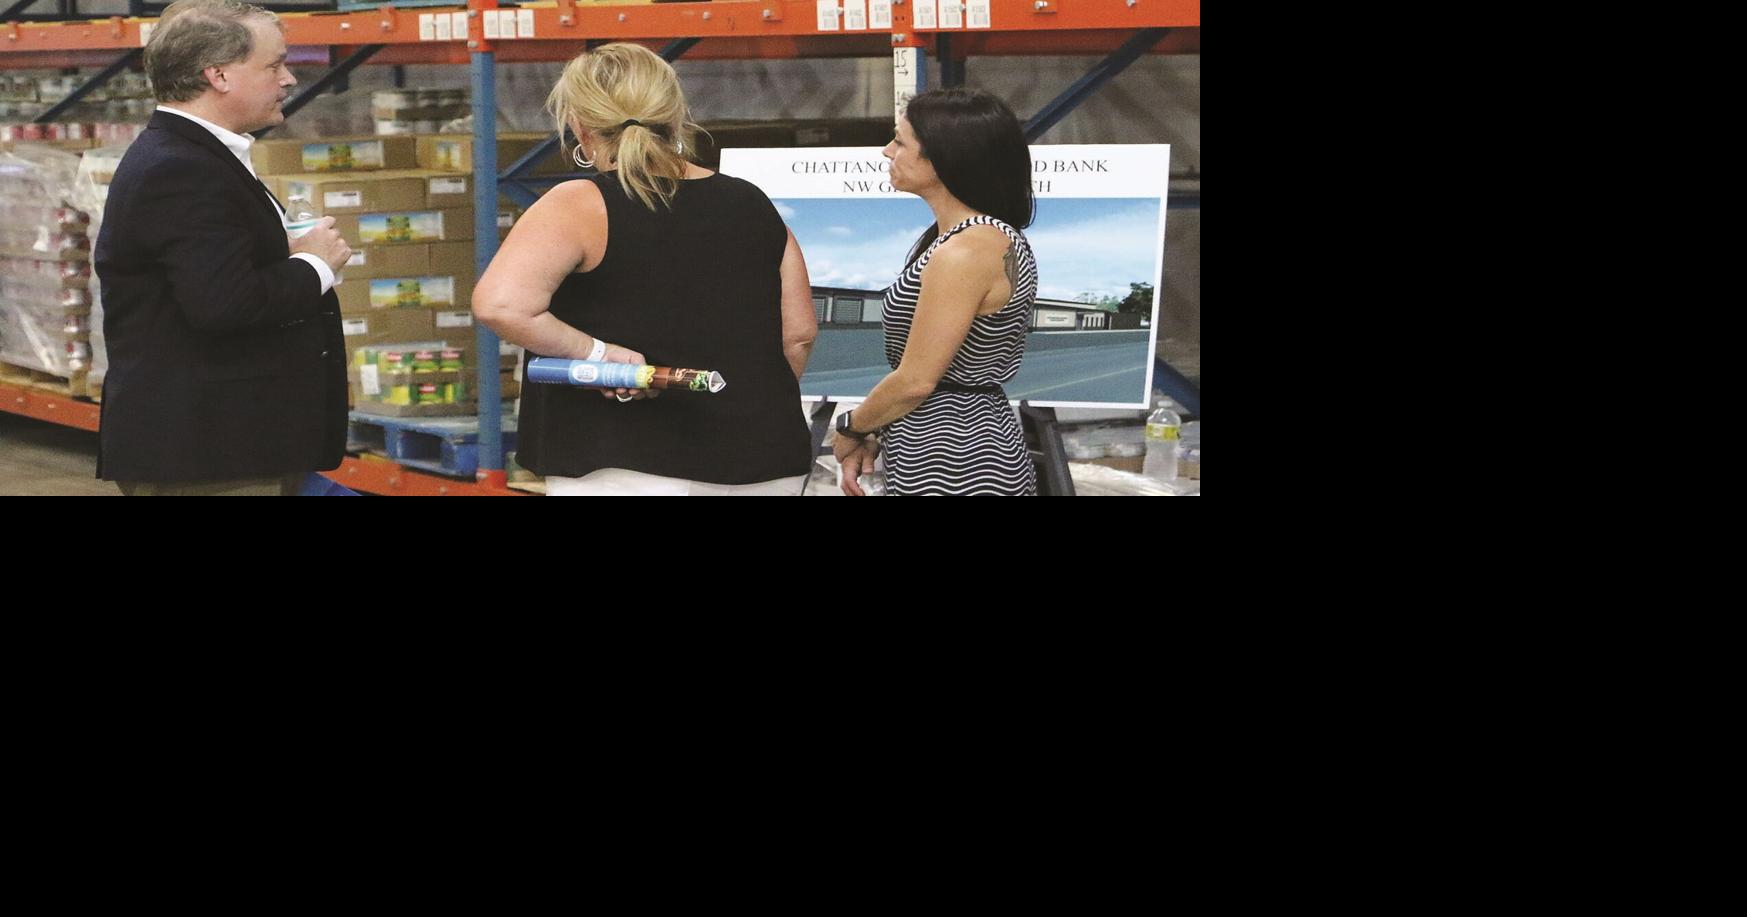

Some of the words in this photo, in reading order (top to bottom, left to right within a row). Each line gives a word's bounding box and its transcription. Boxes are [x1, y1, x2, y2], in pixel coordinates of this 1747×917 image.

[895, 50, 906, 68] 15
[791, 160, 891, 174] CHATTANO
[1053, 160, 1109, 173] BANK
[842, 181, 874, 193] NW
